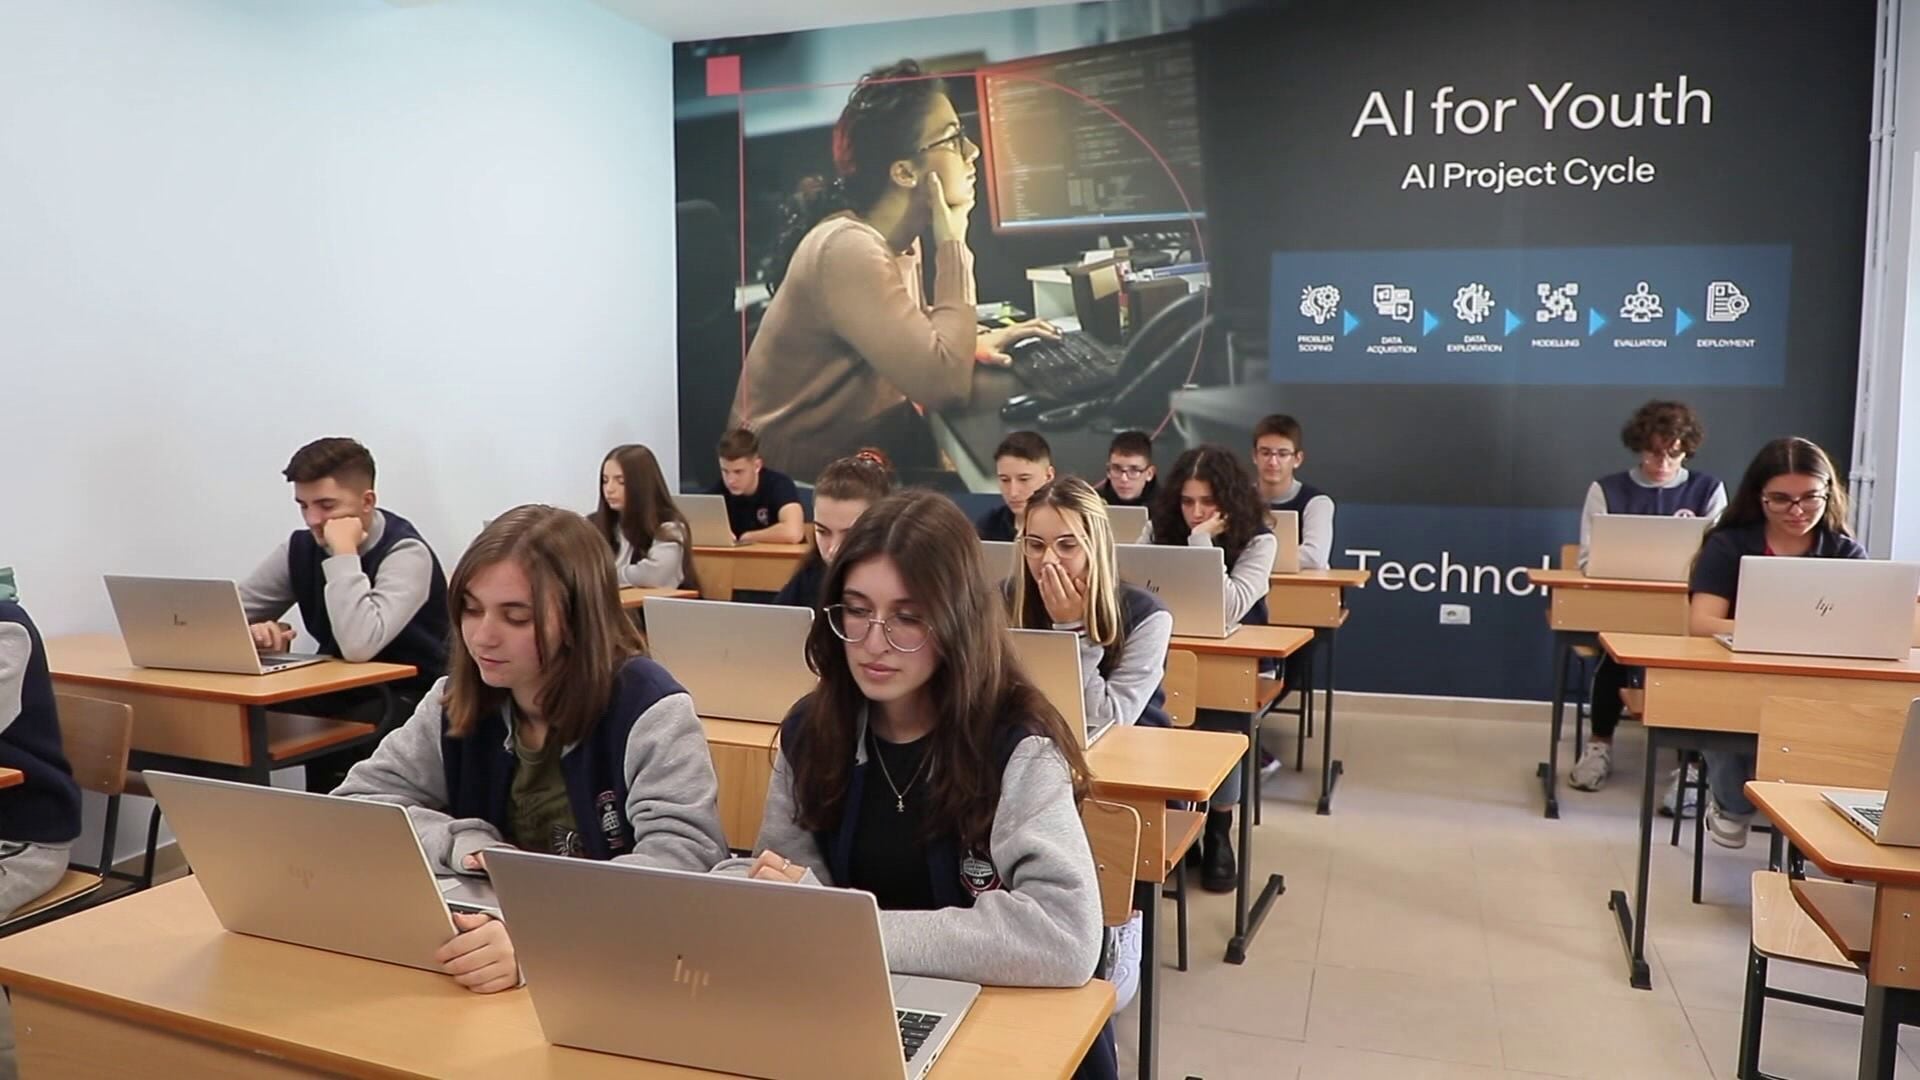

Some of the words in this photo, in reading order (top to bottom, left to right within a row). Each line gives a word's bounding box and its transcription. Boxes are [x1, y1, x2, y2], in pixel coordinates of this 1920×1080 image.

[1351, 89, 1414, 138] AI
[1430, 86, 1517, 135] for
[1527, 75, 1712, 130] Youth
[1401, 163, 1435, 190] AI
[1443, 161, 1557, 194] Project
[1563, 155, 1656, 191] Cycle
[1297, 335, 1335, 343] PROBLEM
[1380, 336, 1403, 344] DATA
[1463, 335, 1486, 343] DATA
[1531, 339, 1580, 347] MODELLING
[1613, 338, 1667, 347] EVALUATION
[1696, 338, 1755, 347] DEPLOYMENT
[1298, 344, 1333, 352] SCOPING
[1366, 345, 1417, 354] ACQUISITION
[1446, 344, 1502, 352] EXPLORATION
